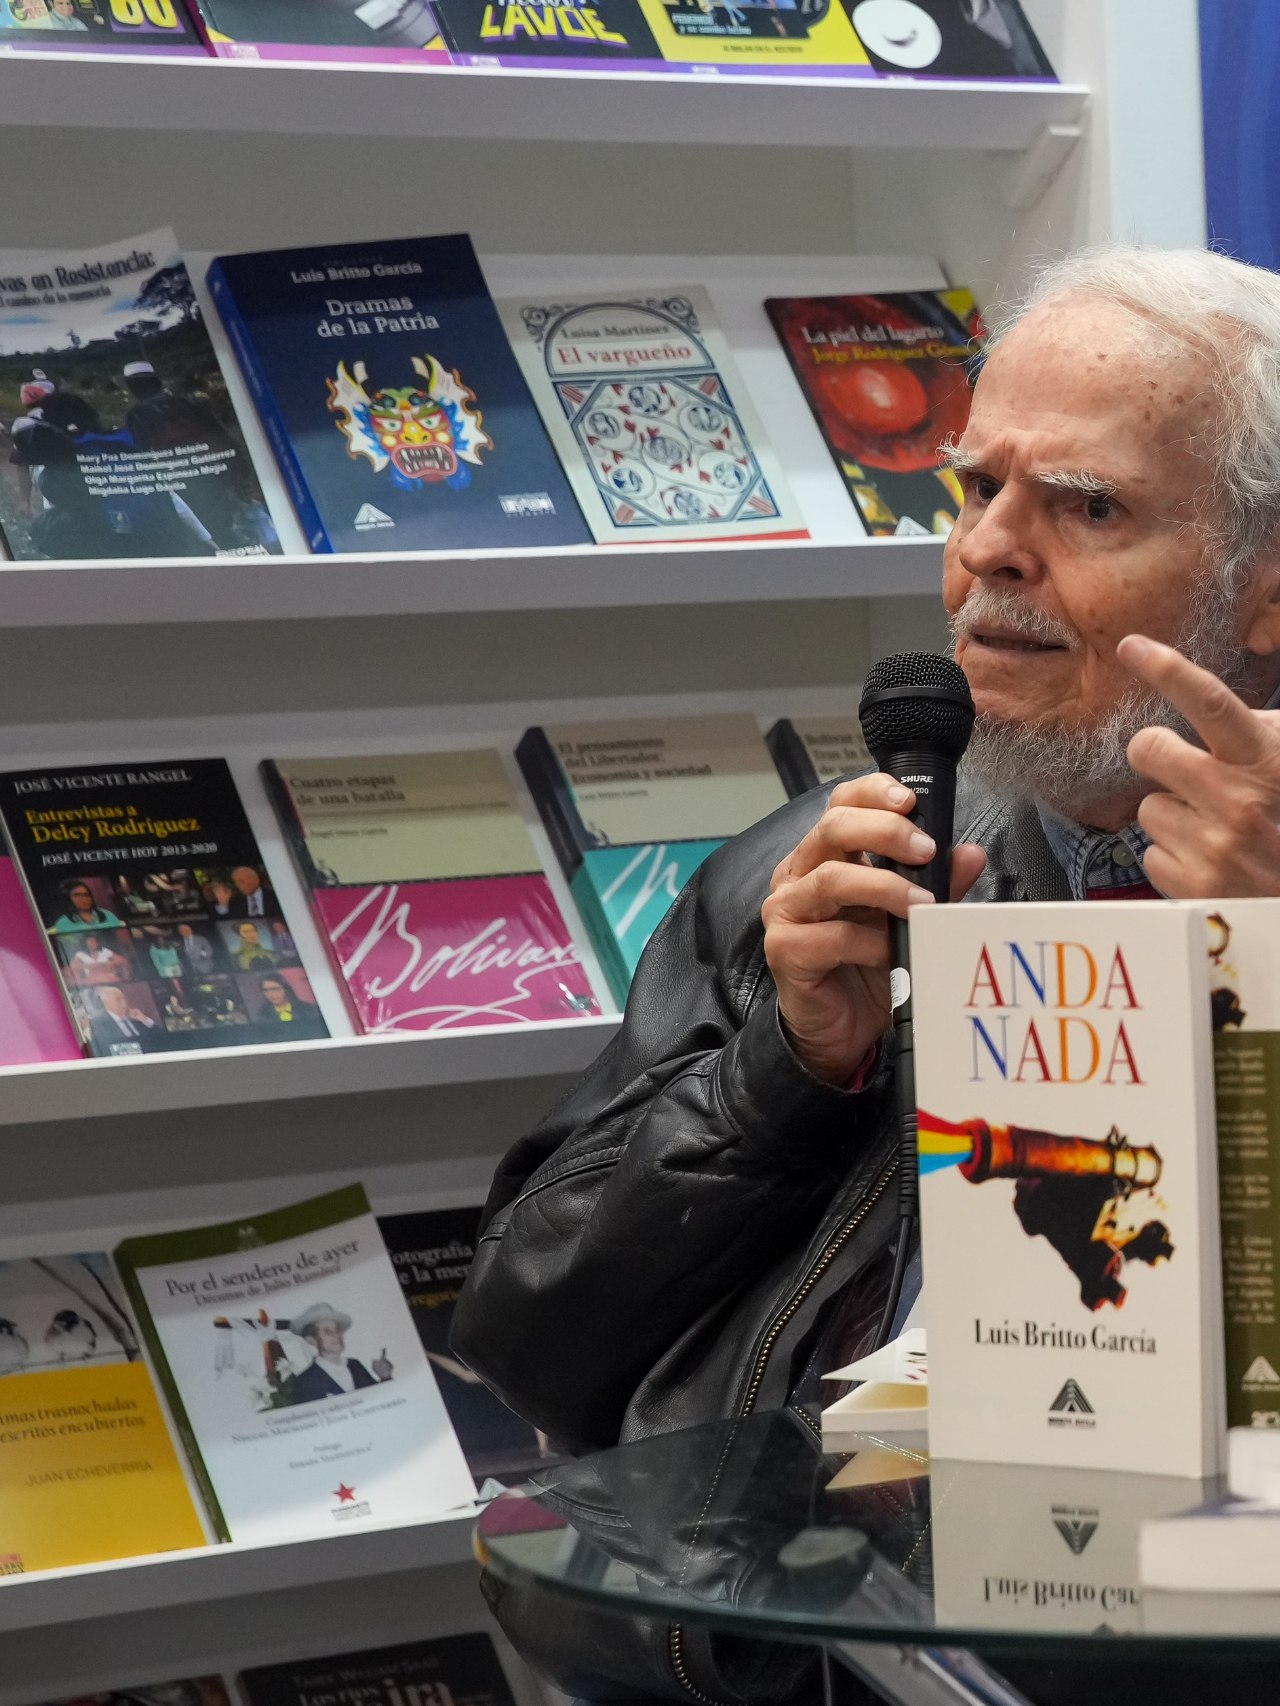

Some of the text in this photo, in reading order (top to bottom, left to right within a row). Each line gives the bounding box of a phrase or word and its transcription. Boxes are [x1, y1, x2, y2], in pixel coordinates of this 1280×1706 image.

[480, 4, 627, 45] LAVOE
[55, 250, 156, 288] Resistencia:
[291, 261, 423, 284] Luis Britto García
[326, 296, 413, 316] Dramas
[317, 312, 440, 338] de la Patria
[561, 325, 600, 339] Luisa
[802, 327, 826, 343] La
[829, 325, 859, 347] piel
[862, 324, 887, 342] del
[557, 344, 692, 367] El vargueño
[564, 754, 586, 767] del
[14, 768, 191, 795] JOSÉ VICENTE RANGEL
[290, 774, 396, 789] Cuatro etapas
[901, 775, 933, 783] SHURE
[296, 789, 406, 804] de una batalla
[26, 806, 138, 825] Entrevistas a
[31, 818, 200, 843] Delcy Rodríguez
[42, 853, 71, 867] JOSÉ
[73, 848, 128, 863] VICENTE
[131, 845, 158, 859] HOY
[964, 941, 1143, 1010] ANDA
[965, 1016, 1147, 1085] NADA
[391, 1240, 474, 1267] otografía
[165, 1240, 359, 1296] Por el sendero de ayer
[400, 1270, 411, 1285] e
[411, 1264, 431, 1283] la
[974, 1317, 1157, 1355] Luis Britto García
[38, 1397, 138, 1421] trasnochadas
[59, 1415, 146, 1437] encubiertos
[26, 1470, 64, 1487] JUAN
